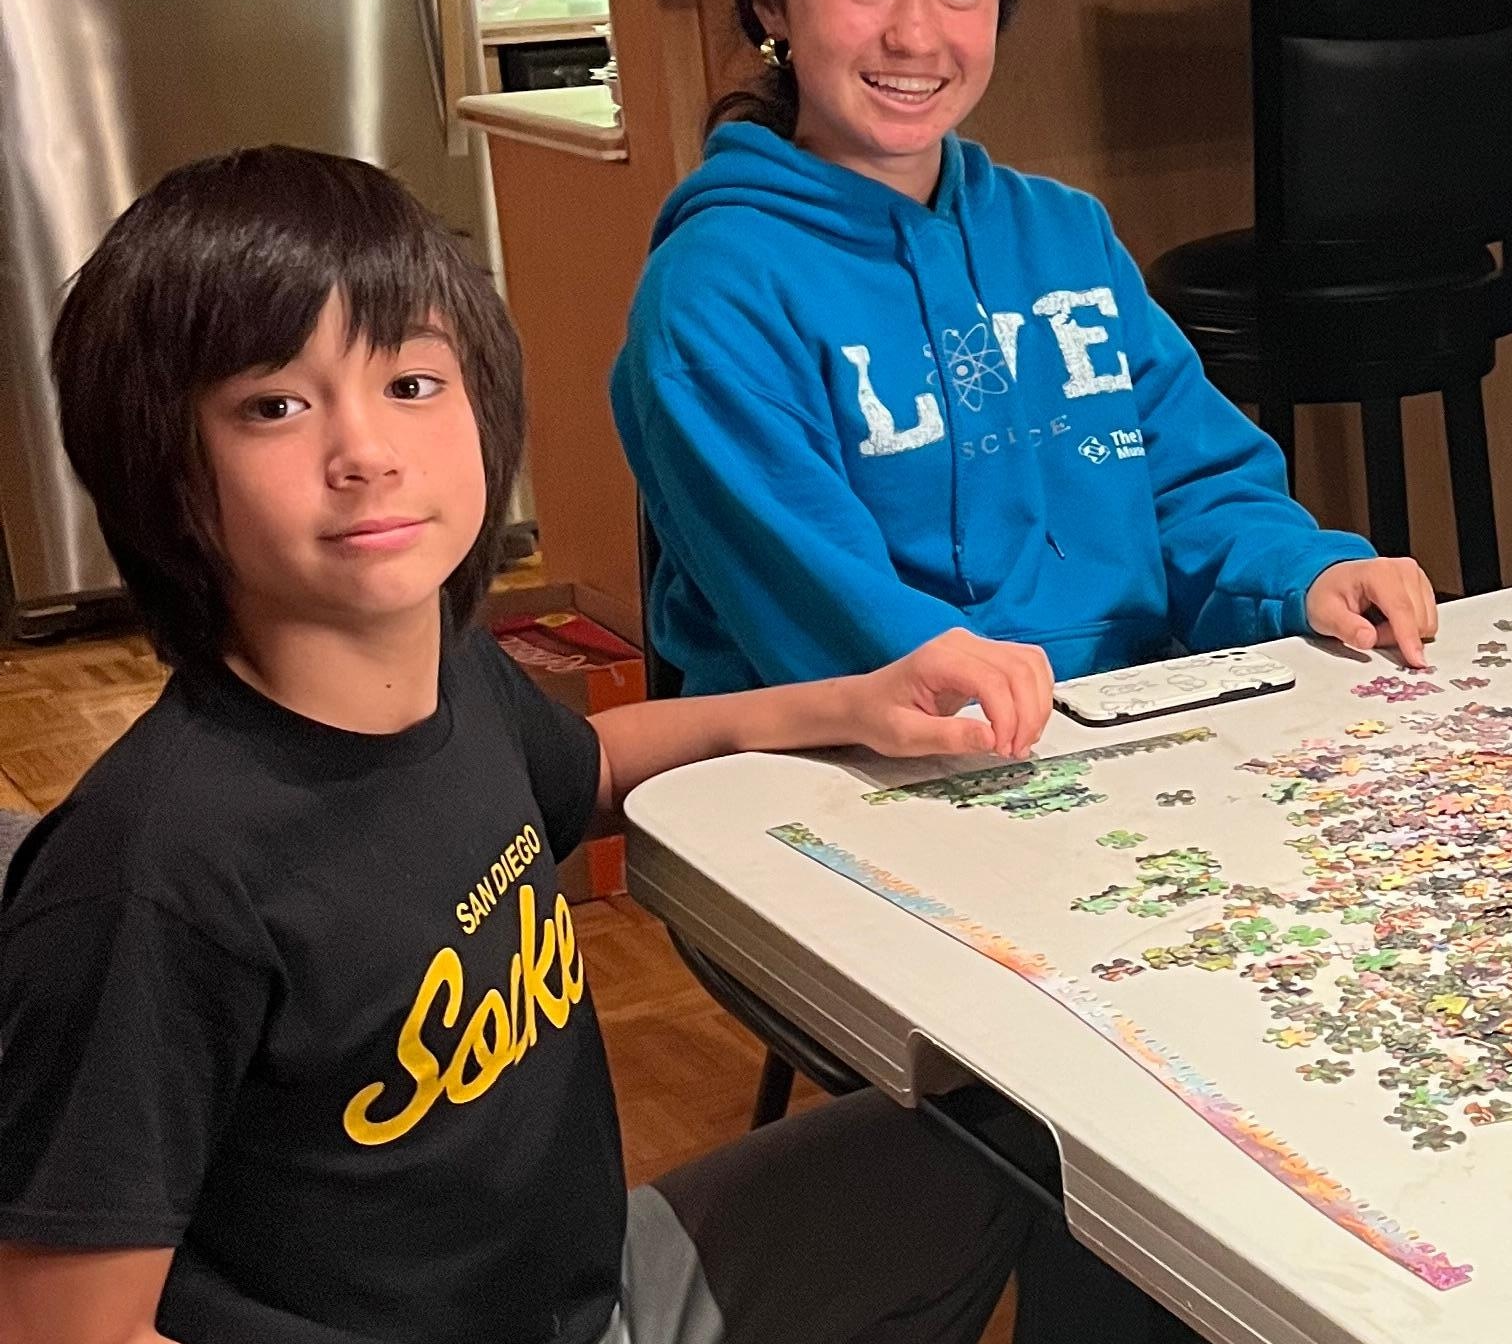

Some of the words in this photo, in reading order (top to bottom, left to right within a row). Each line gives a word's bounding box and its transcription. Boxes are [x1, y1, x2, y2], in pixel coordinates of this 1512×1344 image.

[1109, 429, 1138, 446] The
[456, 876, 497, 935] SAN
[491, 824, 541, 895] DIEGO
